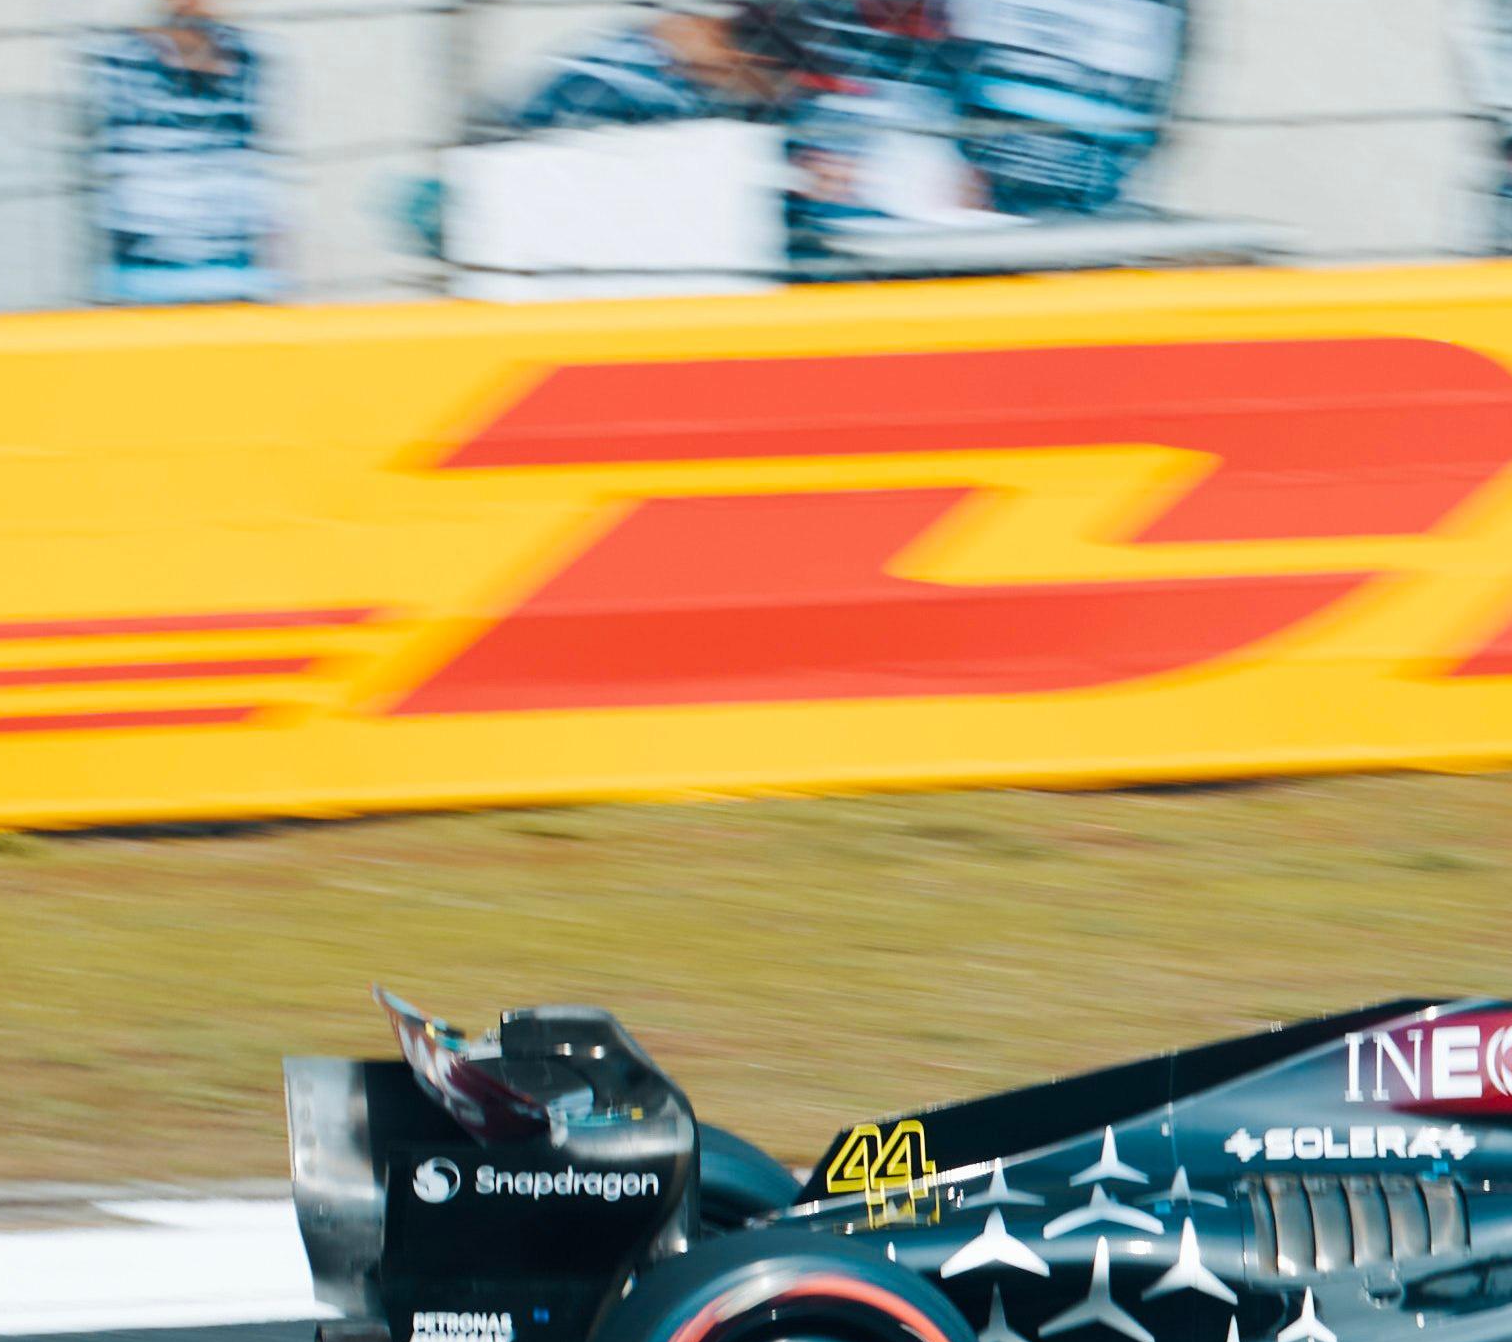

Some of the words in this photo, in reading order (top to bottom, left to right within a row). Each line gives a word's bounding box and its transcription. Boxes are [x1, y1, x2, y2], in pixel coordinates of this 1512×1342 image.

[1264, 1125, 1442, 1160] SOLERA
[475, 1164, 659, 1201] Snapdragon
[827, 1120, 940, 1229] 44
[412, 1311, 513, 1333] PETRONAS
